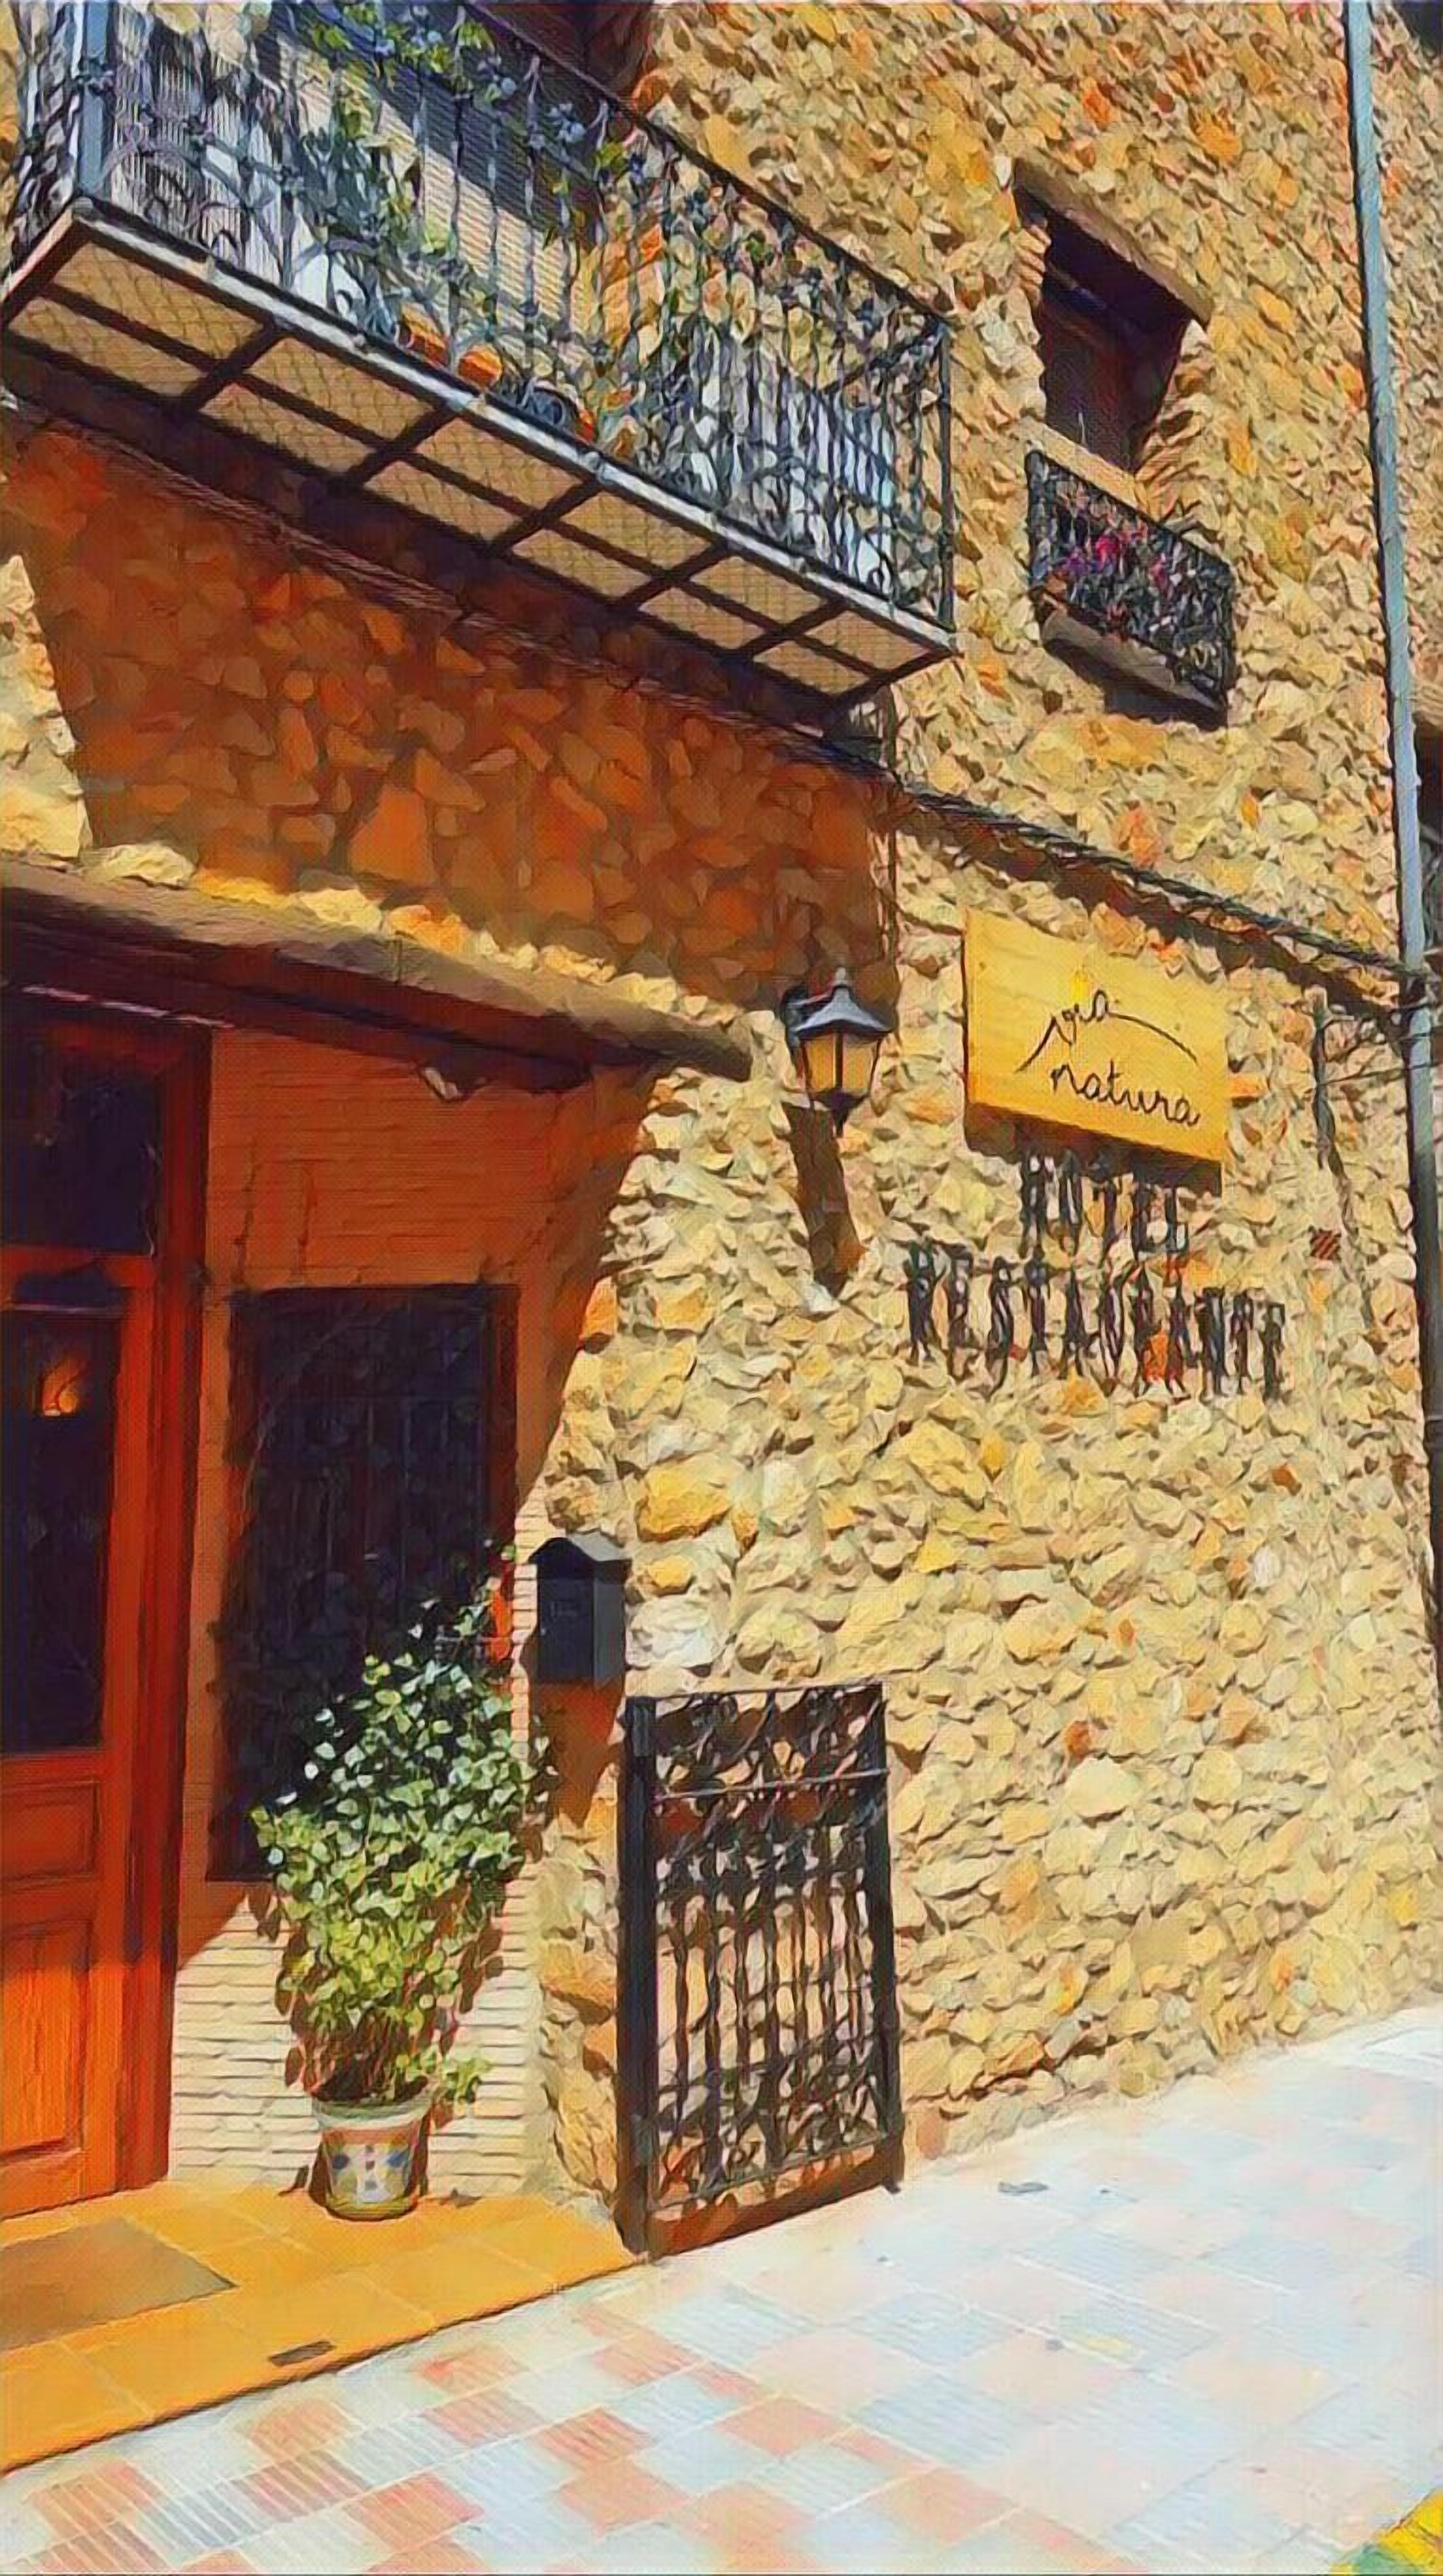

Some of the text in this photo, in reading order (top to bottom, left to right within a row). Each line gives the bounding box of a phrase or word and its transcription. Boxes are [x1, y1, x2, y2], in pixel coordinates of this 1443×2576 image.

[1050, 1058, 1201, 1127] natura
[1020, 1150, 1189, 1257] HOTEL
[904, 1238, 1285, 1397] RESTAURANTE
